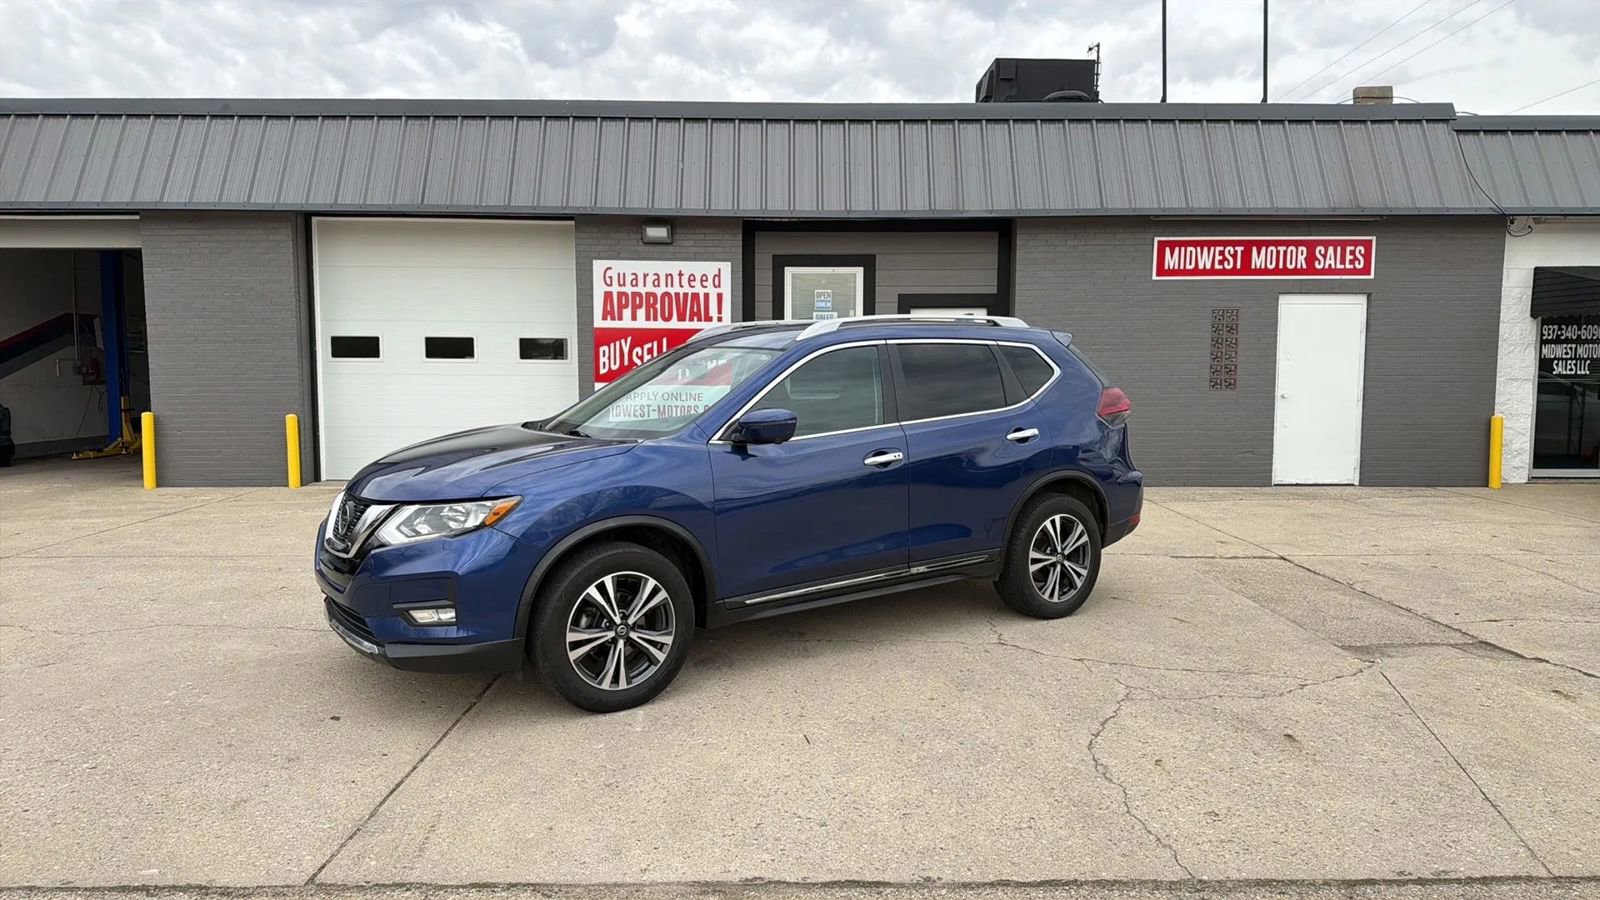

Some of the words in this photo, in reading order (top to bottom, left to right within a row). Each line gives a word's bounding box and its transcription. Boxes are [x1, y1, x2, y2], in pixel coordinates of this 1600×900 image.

[1164, 246, 1244, 270] MIDWEST
[1251, 245, 1307, 270] MOTOR
[1314, 245, 1365, 270] SALES
[603, 266, 722, 288] Guaranteed
[602, 291, 723, 322] APPROVAL!
[1542, 324, 1600, 340] 937-340-609
[599, 335, 632, 375] BUY
[1541, 343, 1576, 359] MIDWEST
[1552, 360, 1576, 375] SALES
[1577, 360, 1591, 375] LLC
[625, 391, 659, 401] APPLY
[661, 391, 704, 402] ONLINE
